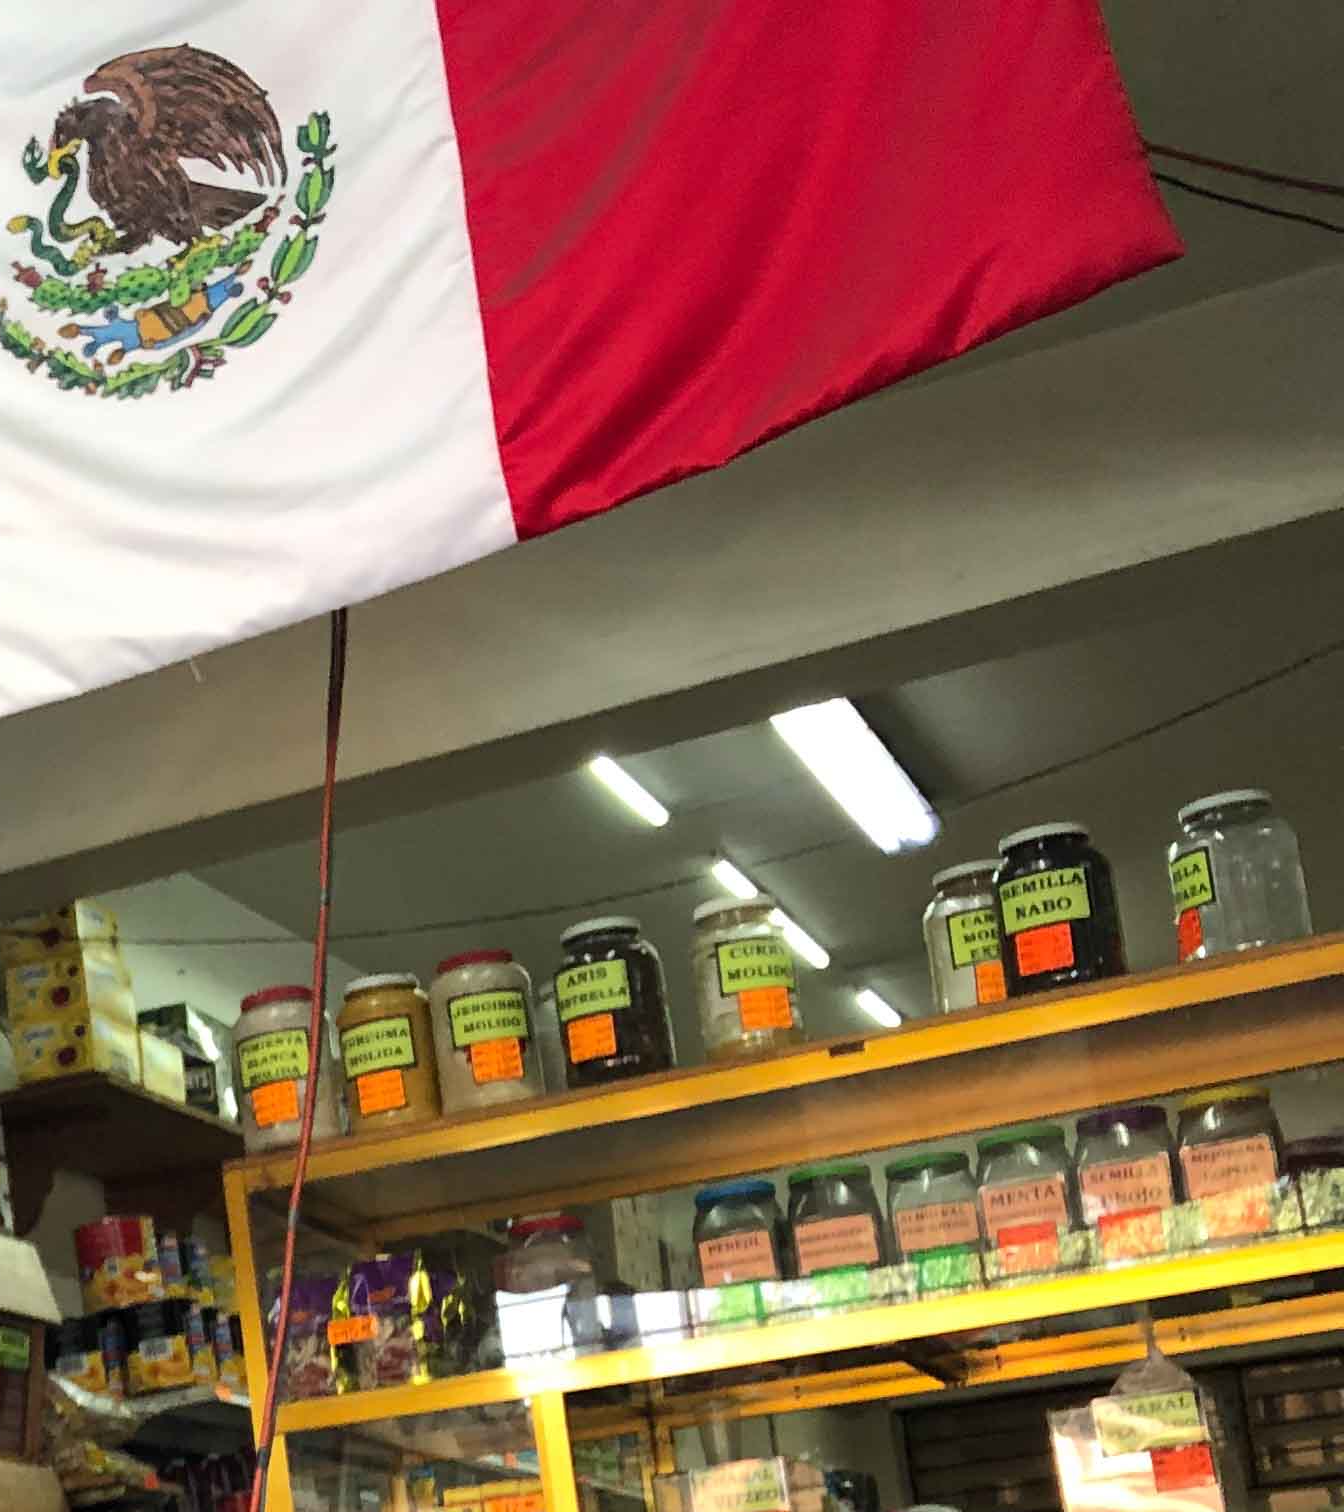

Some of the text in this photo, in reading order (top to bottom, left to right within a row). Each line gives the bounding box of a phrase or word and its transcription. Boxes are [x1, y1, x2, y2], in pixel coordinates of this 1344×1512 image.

[1001, 870, 1084, 901] SEMILLA
[1015, 896, 1072, 920] NABO
[566, 966, 609, 987] ANIS
